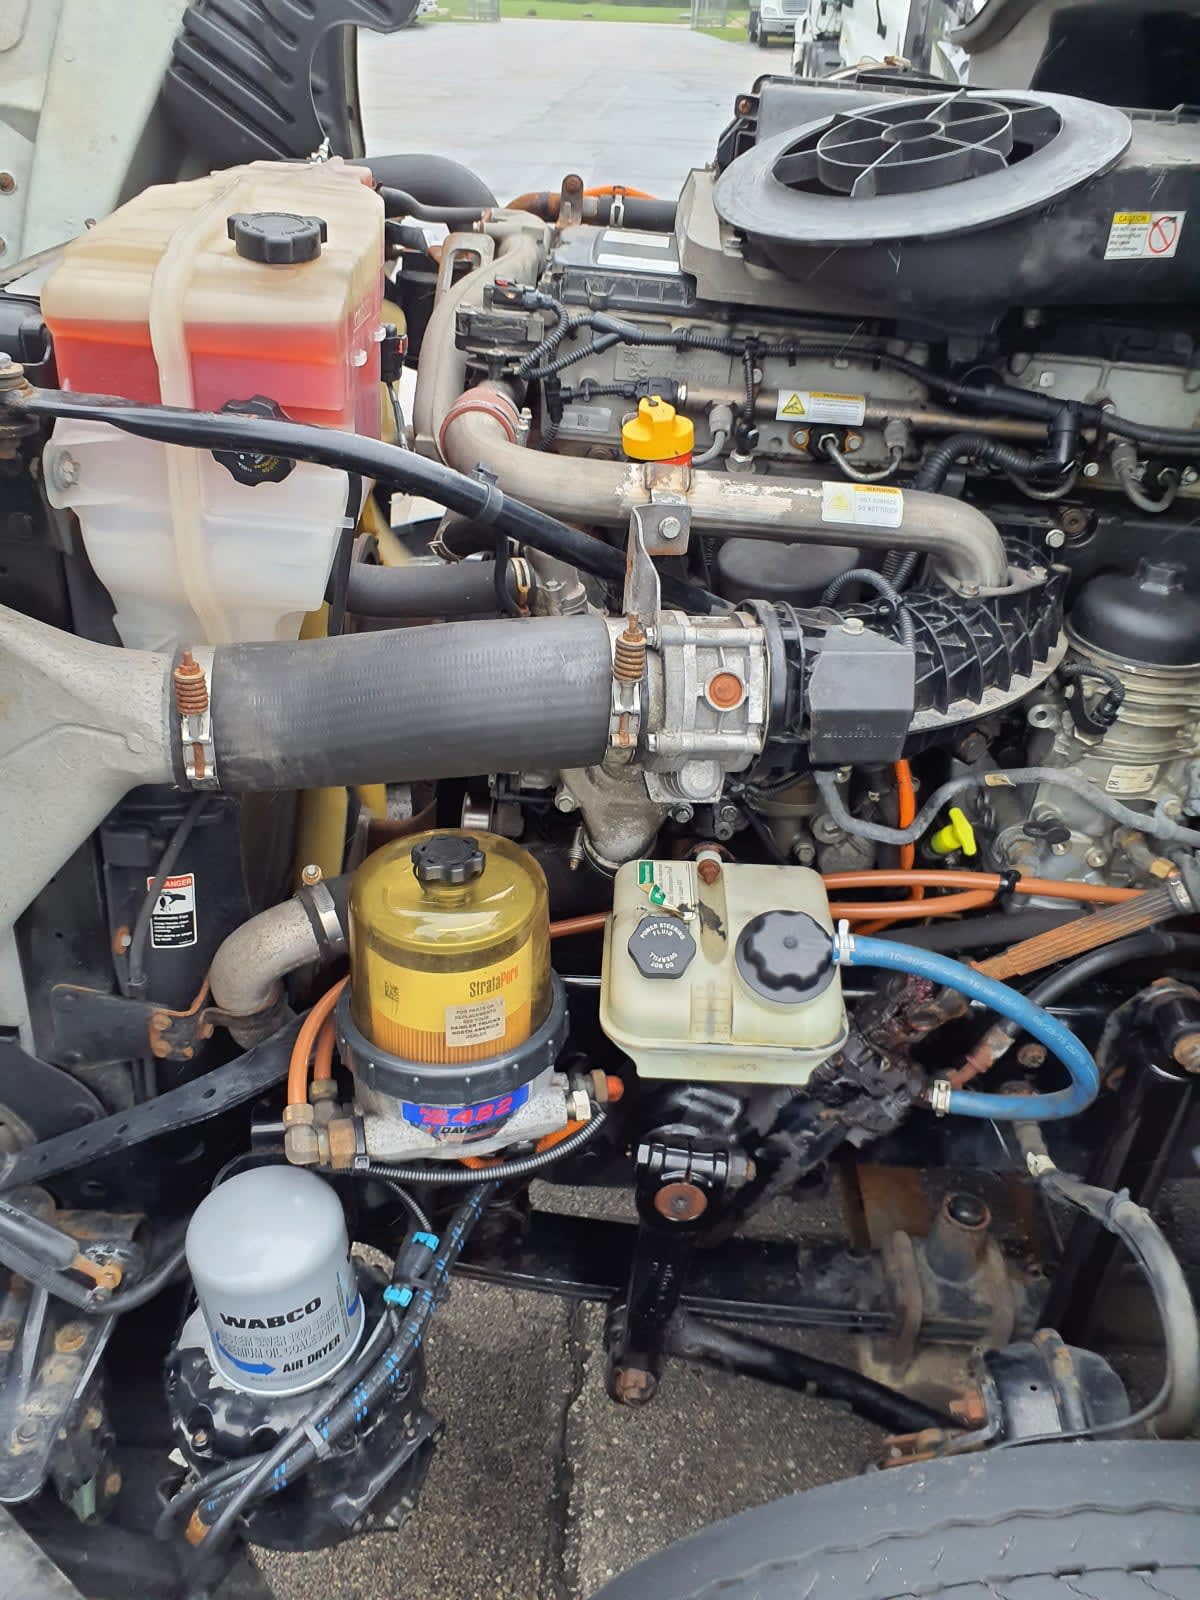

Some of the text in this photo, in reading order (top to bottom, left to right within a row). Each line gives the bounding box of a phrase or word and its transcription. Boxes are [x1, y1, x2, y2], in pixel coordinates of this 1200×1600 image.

[164, 878, 192, 888] ANGER
[640, 922, 686, 940] POWER STEERING
[652, 928, 673, 937] FLUID
[648, 951, 678, 963] OVERFILL
[650, 961, 675, 969] DO NOT
[219, 1297, 321, 1330] WABCO
[283, 1333, 341, 1373] AIR DRYER
